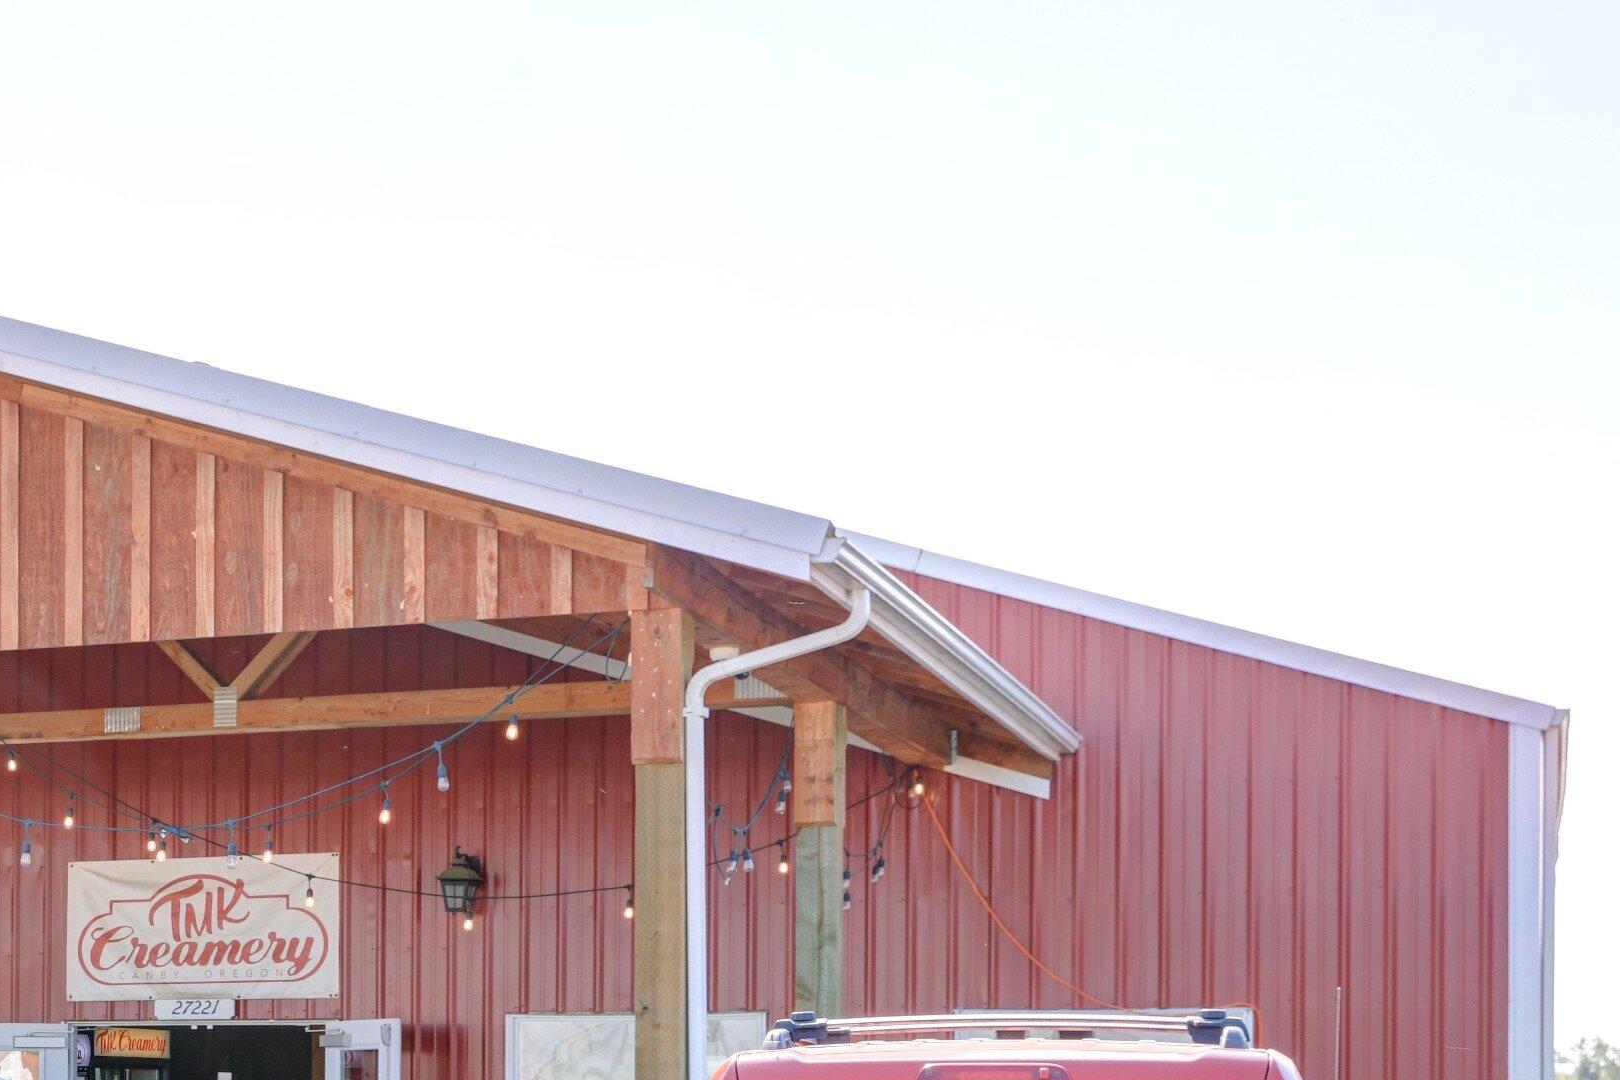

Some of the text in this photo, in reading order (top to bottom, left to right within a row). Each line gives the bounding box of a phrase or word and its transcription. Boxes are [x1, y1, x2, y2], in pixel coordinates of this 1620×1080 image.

[149, 878, 251, 942] TMK
[90, 925, 314, 976] Creamery
[204, 968, 283, 980] OREGON
[172, 1000, 219, 1015] 27221
[118, 1029, 166, 1056] Creamery
